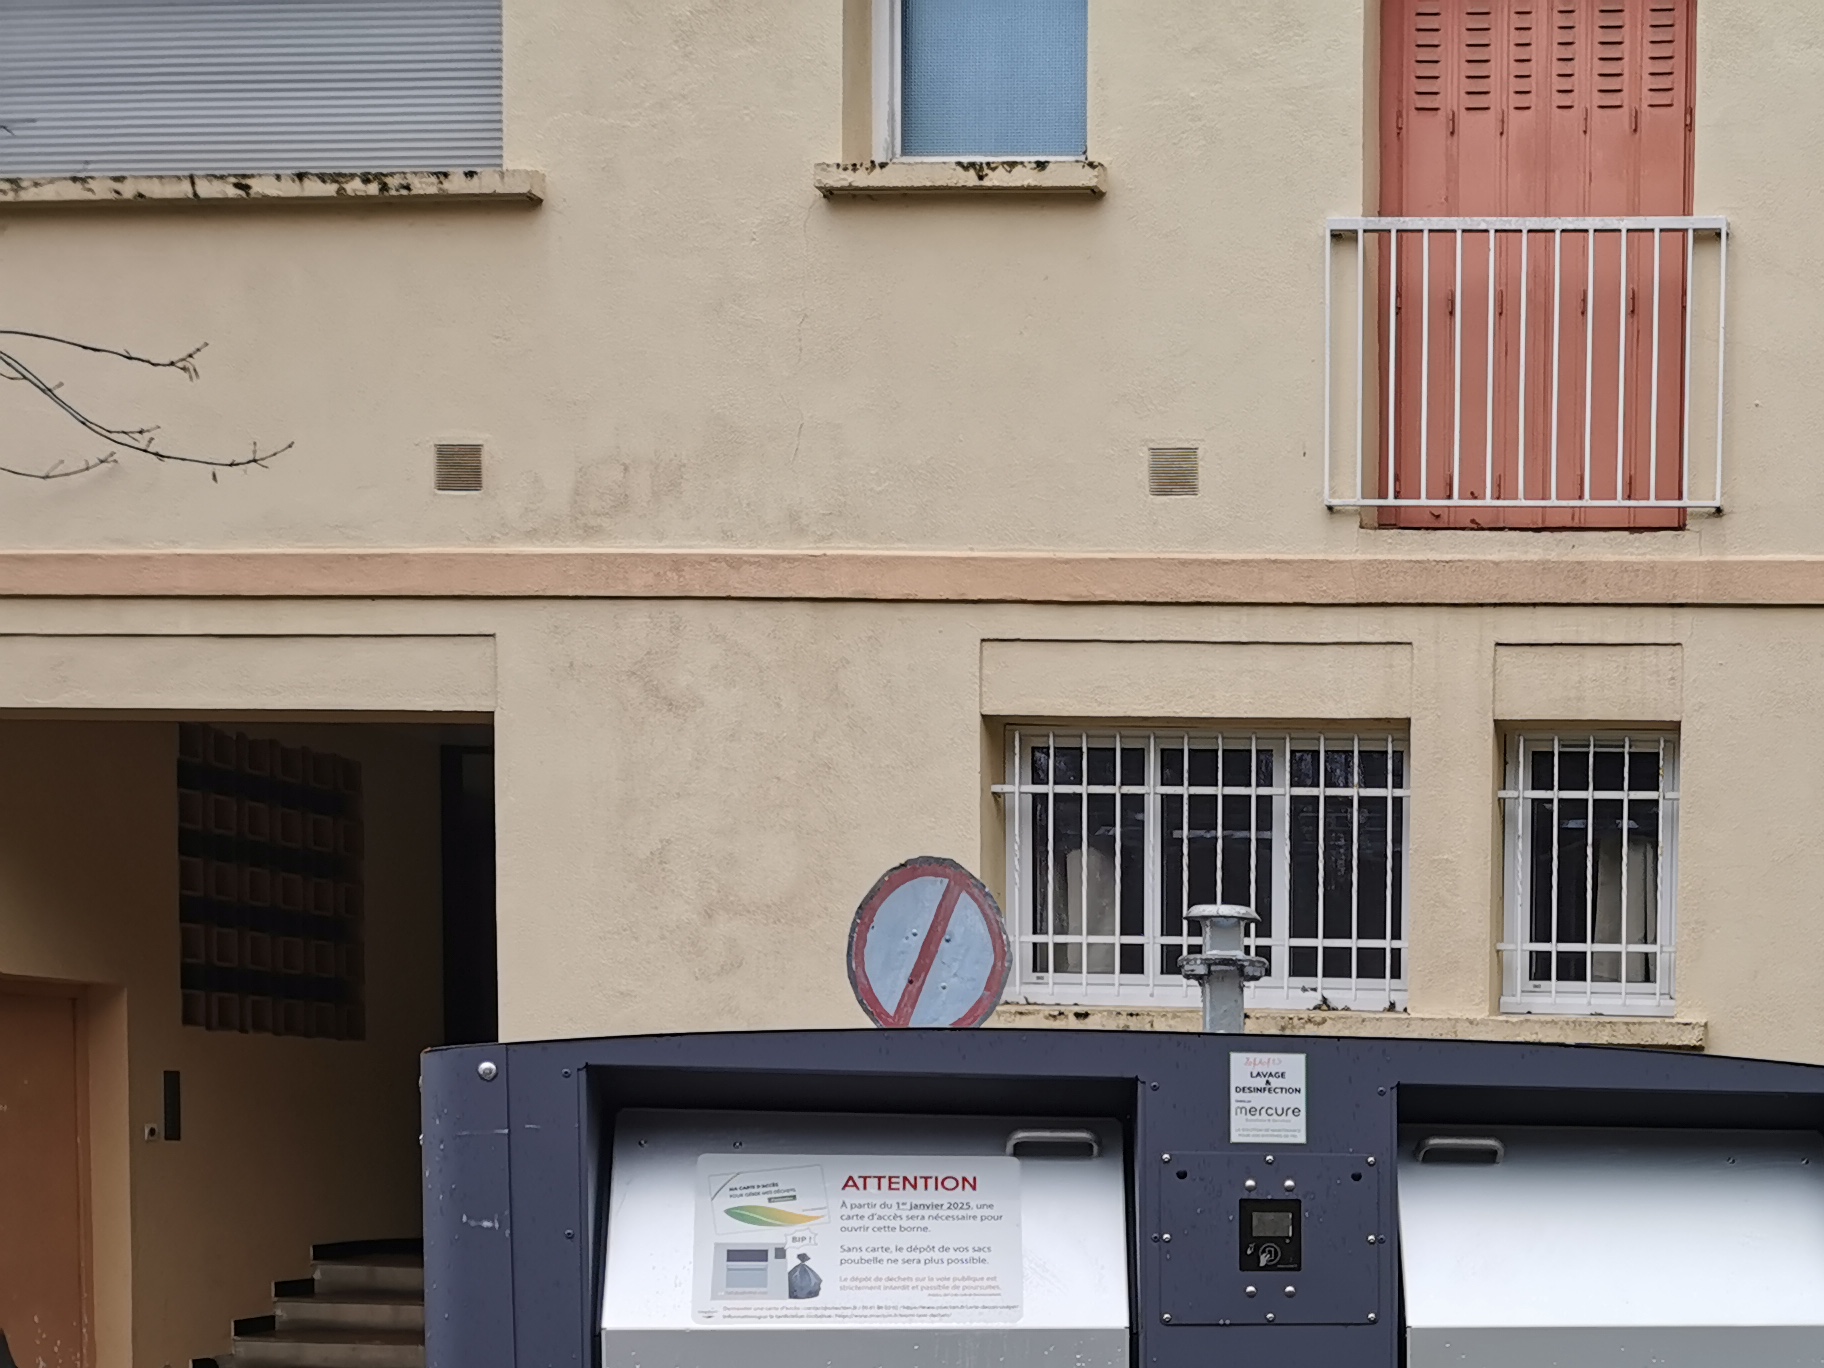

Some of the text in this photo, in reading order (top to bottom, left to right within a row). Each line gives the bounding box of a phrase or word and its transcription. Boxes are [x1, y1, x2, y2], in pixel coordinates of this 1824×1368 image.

[1235, 1086, 1301, 1094] DESINFECTION
[1235, 1106, 1301, 1117] mercure
[841, 1175, 977, 1192] ATTENTION
[850, 1202, 876, 1210] partir
[909, 1202, 944, 1211] janvier
